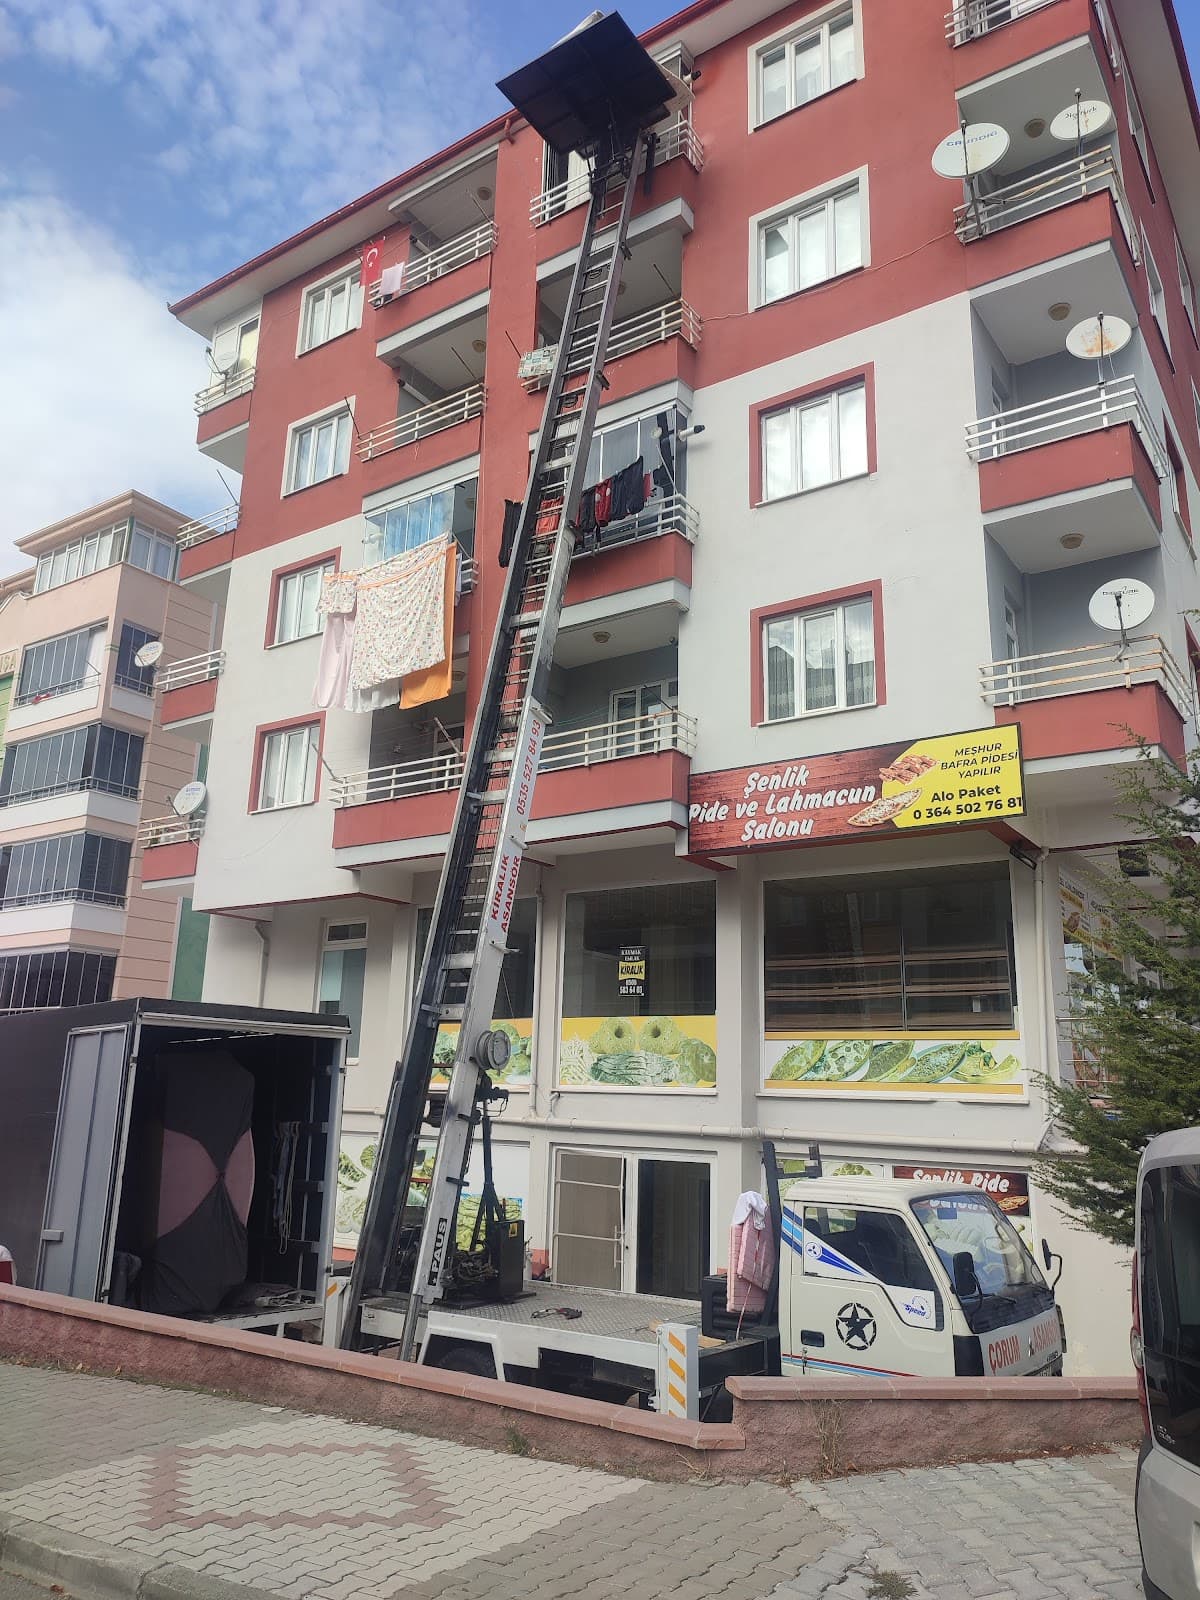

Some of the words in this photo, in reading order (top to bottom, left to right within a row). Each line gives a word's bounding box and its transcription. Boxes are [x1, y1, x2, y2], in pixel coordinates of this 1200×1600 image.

[531, 720, 541, 737] 93
[528, 738, 538, 755] 84
[523, 755, 534, 781] 527
[941, 758, 978, 770] BAFRA
[981, 749, 1018, 765] PİDESİ
[743, 764, 811, 799] Şenlik
[958, 766, 1001, 779] YAPILIR
[516, 782, 529, 816] 0535
[689, 800, 729, 823] Pide
[735, 800, 758, 818] ve
[765, 785, 876, 815] Lahmacun
[931, 791, 955, 803] Alo
[959, 784, 1001, 799] Paket
[913, 809, 922, 820] 0
[926, 806, 952, 819] 364
[956, 802, 982, 815] 502
[985, 799, 1003, 811] 76
[1008, 796, 1022, 808] 81
[741, 817, 815, 842] Salonu
[501, 855, 521, 933] ASANSÖR
[970, 1172, 1010, 1193] Pide
[431, 1220, 447, 1273] PAUS
[904, 1303, 927, 1316] Speed
